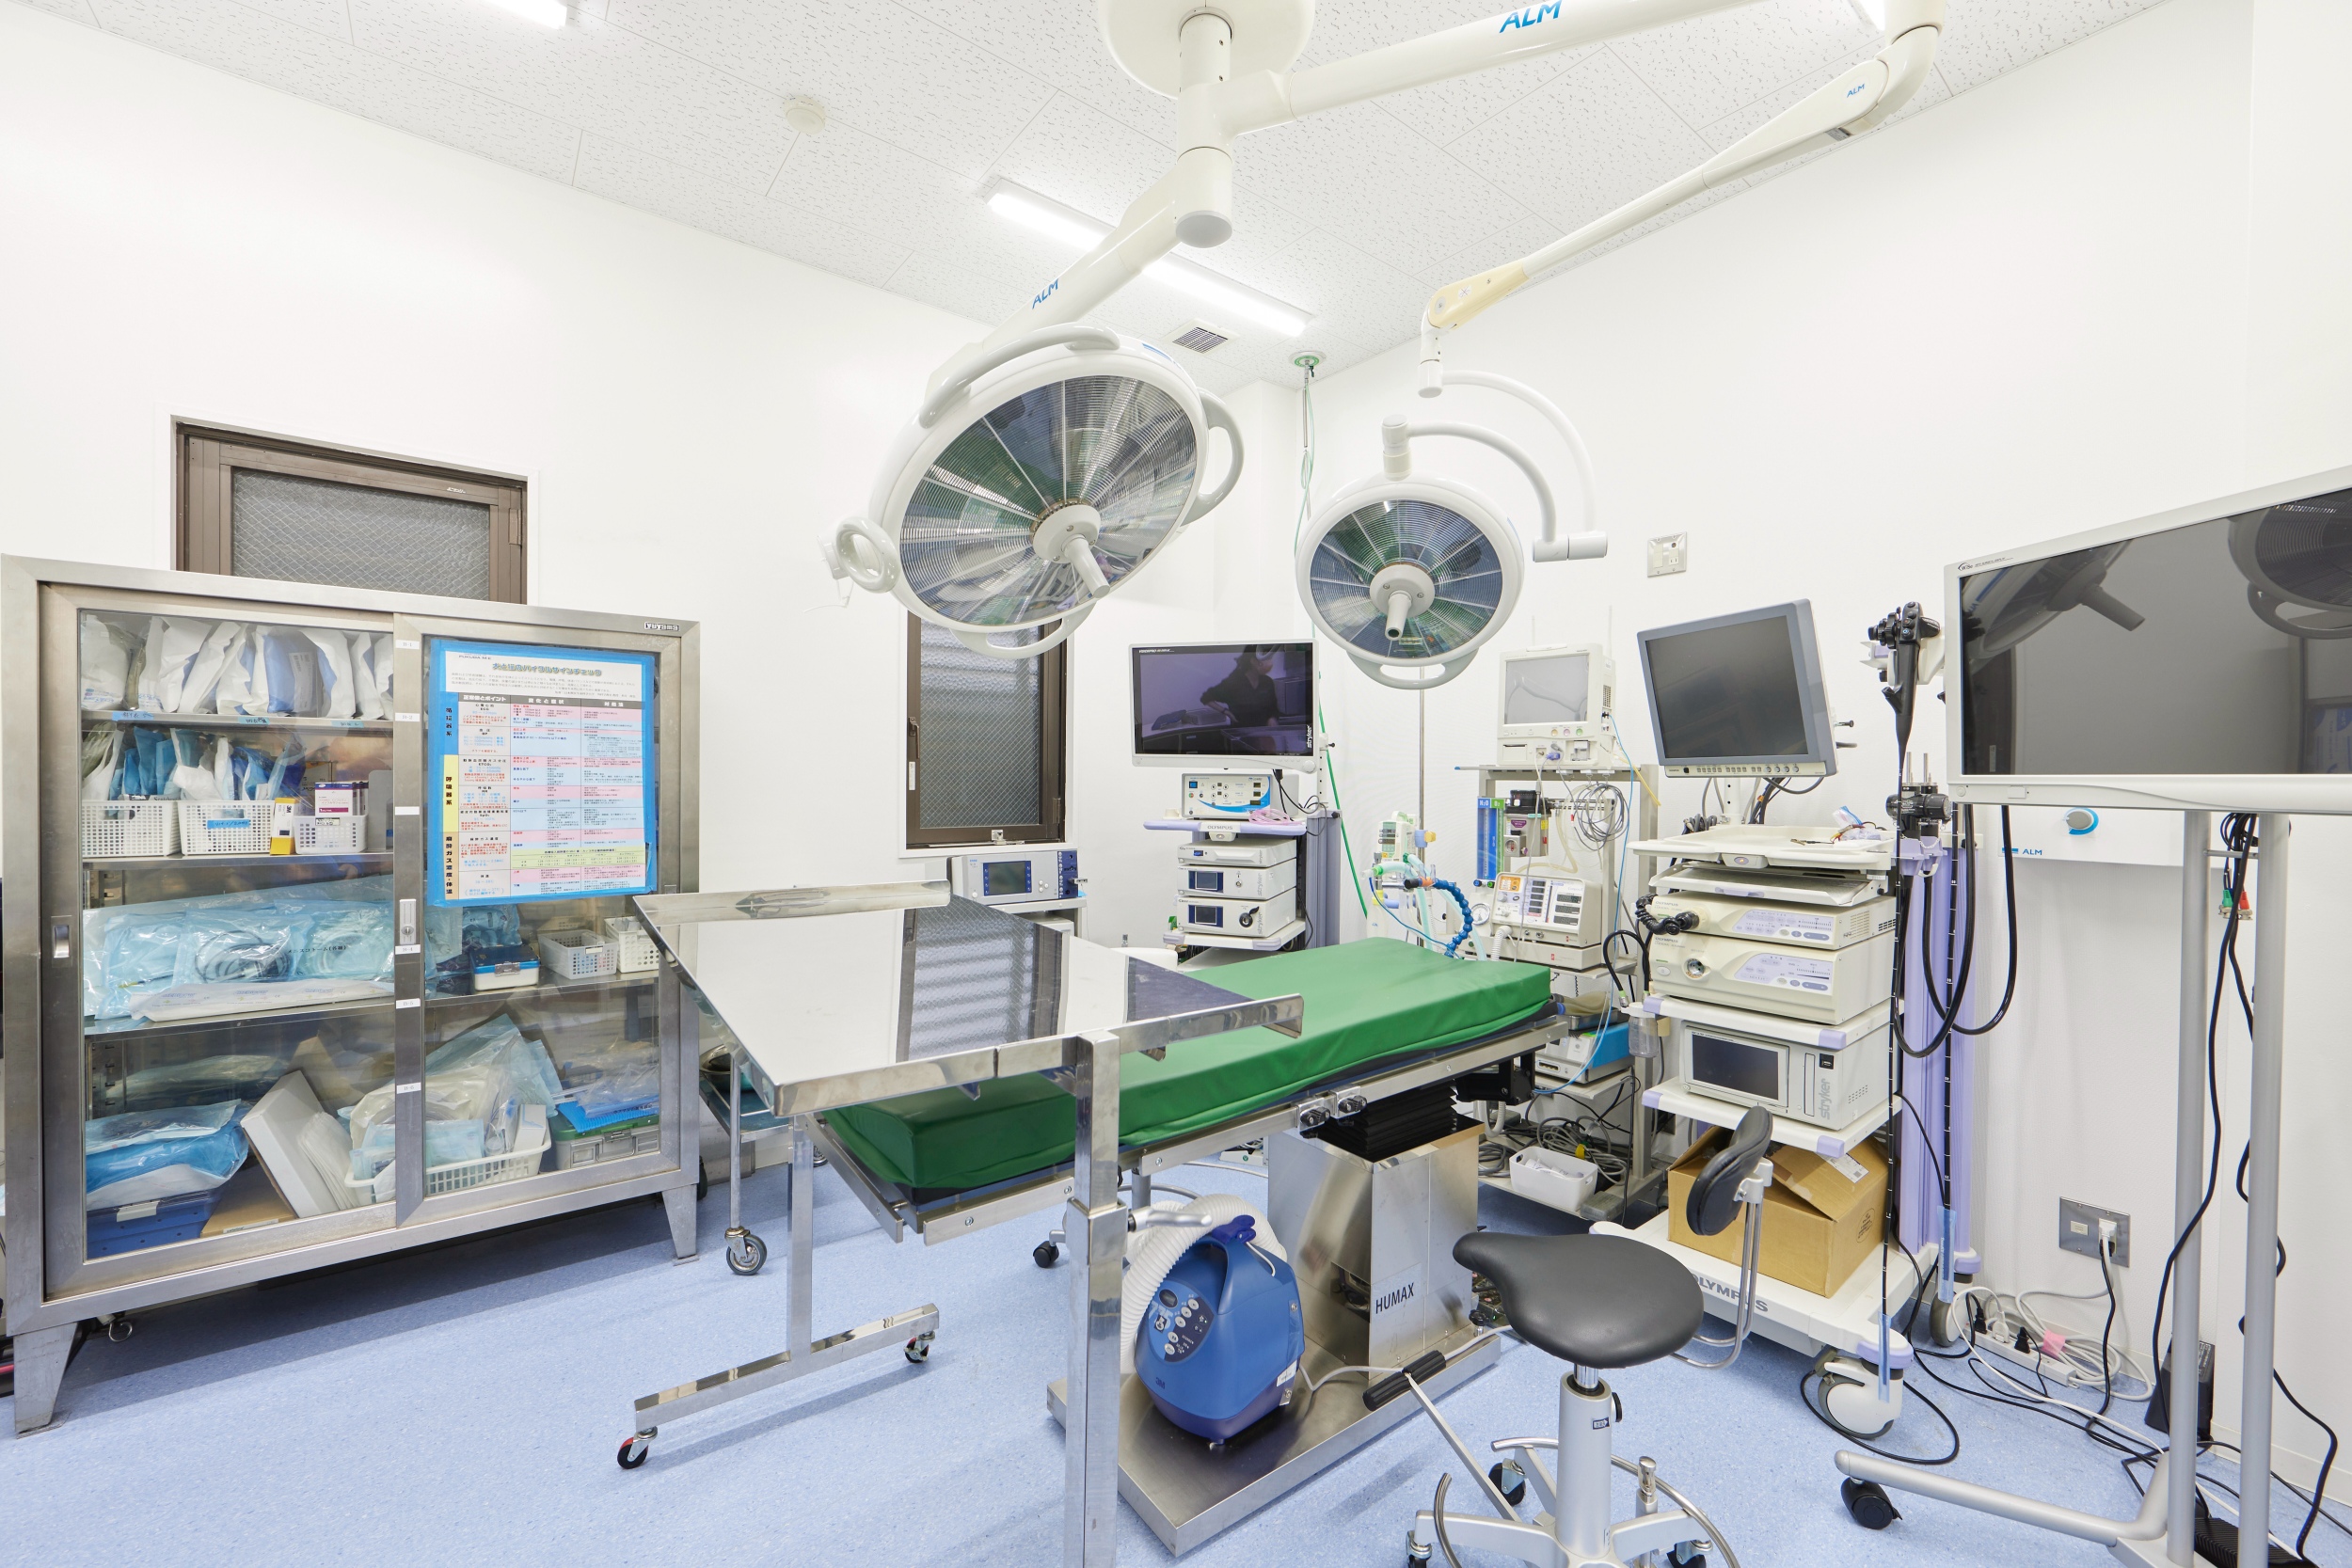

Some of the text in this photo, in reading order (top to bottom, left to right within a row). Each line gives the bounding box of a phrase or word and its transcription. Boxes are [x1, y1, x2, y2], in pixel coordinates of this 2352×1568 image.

[1500, 0, 1562, 33] ALM
[1847, 84, 1865, 98] ALM
[1032, 278, 1058, 309] ALM
[1818, 1078, 1832, 1120] stryker
[1376, 1282, 1414, 1314] HUMAX
[1156, 1377, 1165, 1389] 3M
